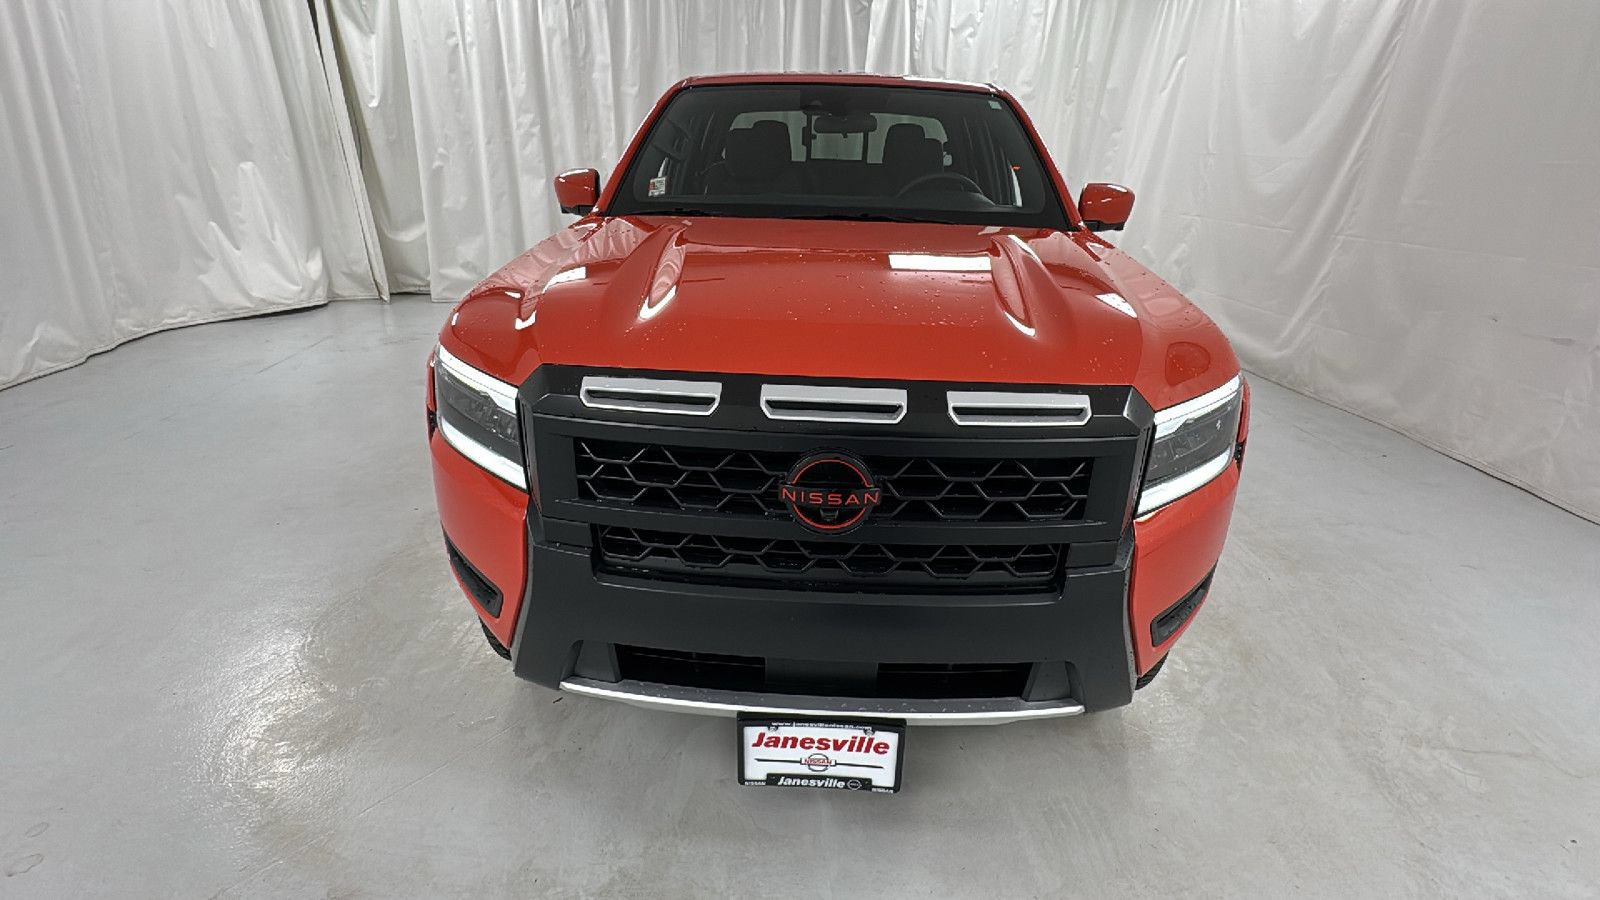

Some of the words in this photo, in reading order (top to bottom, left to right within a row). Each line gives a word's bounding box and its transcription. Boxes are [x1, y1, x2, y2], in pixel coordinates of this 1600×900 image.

[781, 487, 879, 506] NISSAN
[752, 732, 890, 755] Janesville
[778, 776, 846, 789] Janesville
